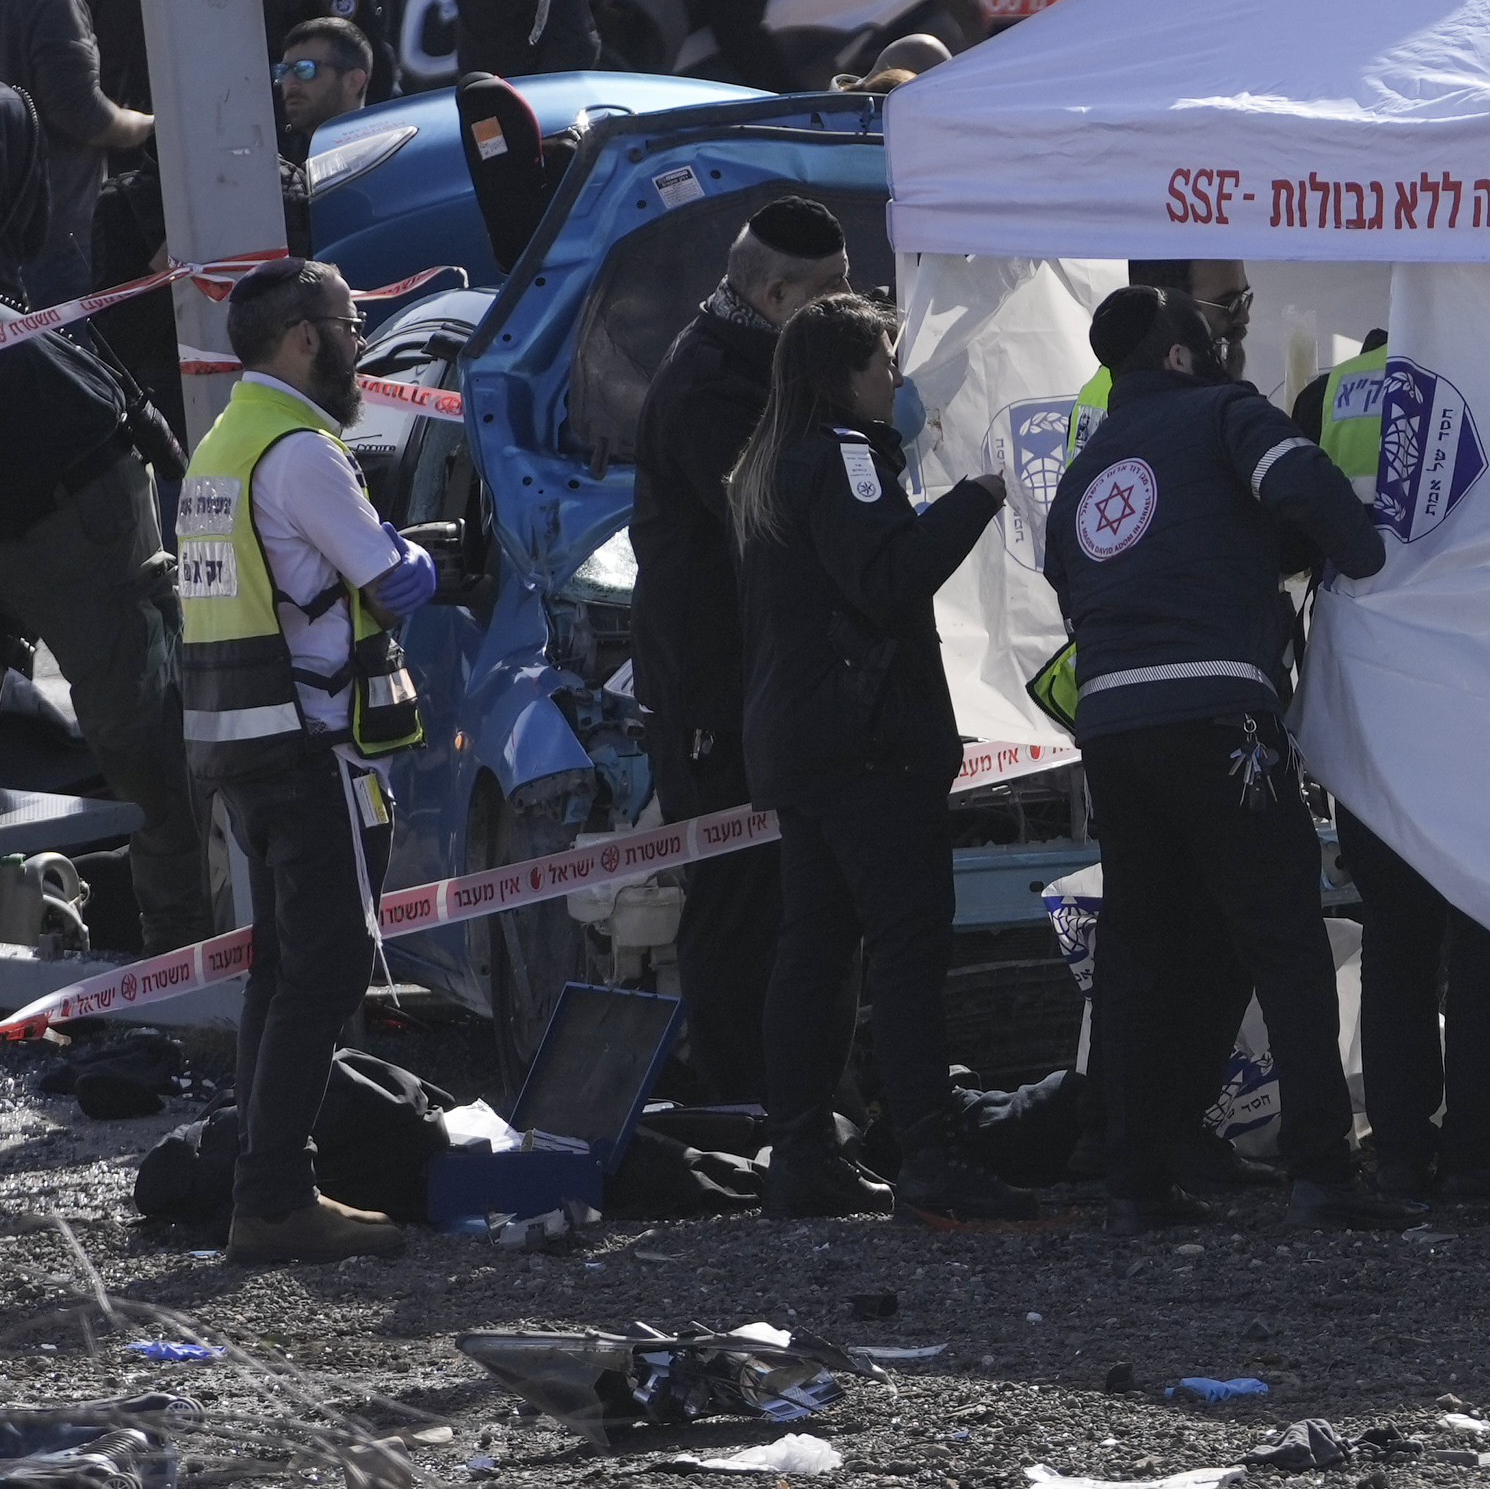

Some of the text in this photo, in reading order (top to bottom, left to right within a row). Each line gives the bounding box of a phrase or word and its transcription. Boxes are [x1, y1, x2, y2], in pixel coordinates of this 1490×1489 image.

[1269, 171, 1384, 230] גבולות
[1394, 170, 1463, 229] ללא
[1425, 408, 1453, 516] חסד של אמת
[1094, 546, 1114, 556] DAVID
[1114, 533, 1134, 552] ADOM
[959, 747, 1019, 777] אין מעב
[703, 811, 769, 845] אין מעבר
[548, 835, 681, 886] משטרת ישראל
[453, 878, 521, 908] אין מעבר
[208, 944, 244, 971] מעבר
[76, 962, 190, 1016] משטרת ישראל
[1241, 1094, 1271, 1113] חסד
